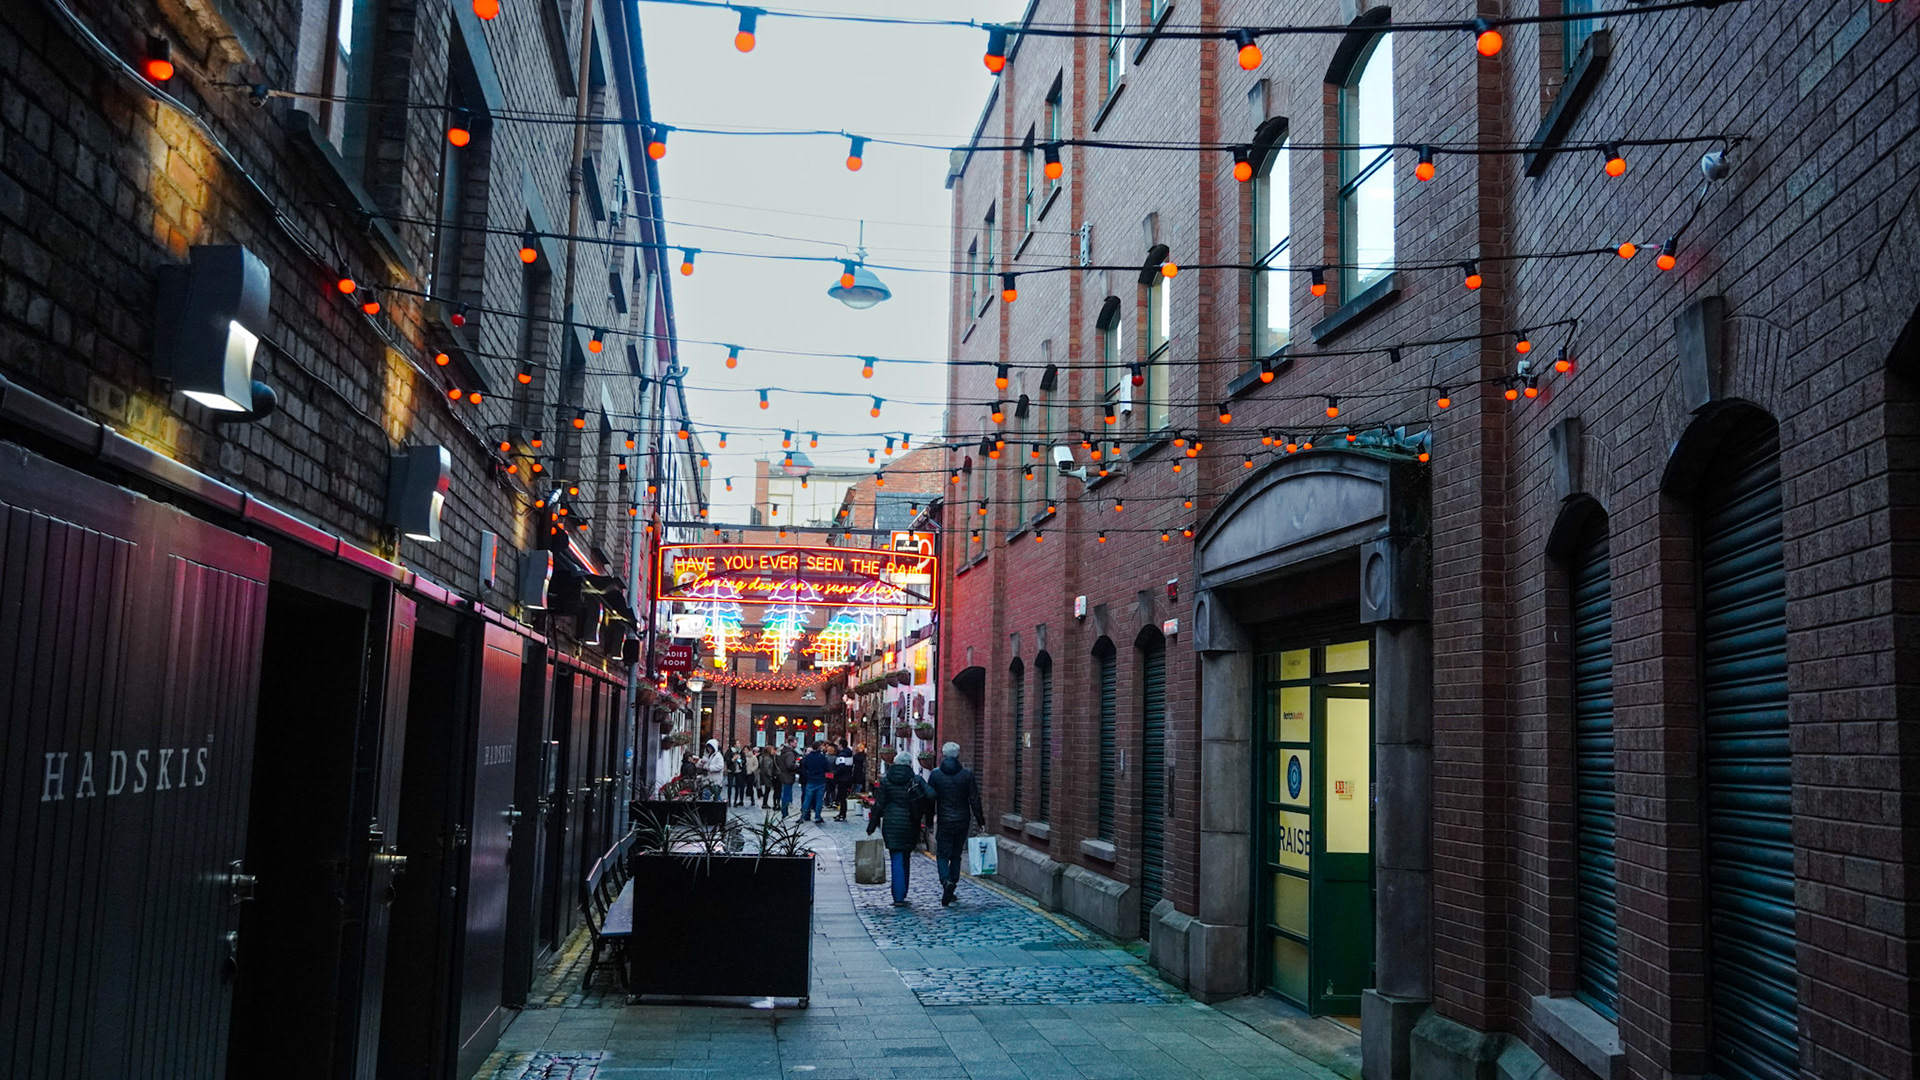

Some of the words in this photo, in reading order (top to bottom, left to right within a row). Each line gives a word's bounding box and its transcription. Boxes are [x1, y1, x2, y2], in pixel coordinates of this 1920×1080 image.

[674, 556, 716, 571] HAVE
[723, 555, 754, 570] YOU
[760, 555, 798, 570] EVER
[806, 556, 844, 572] SEEN
[851, 559, 881, 575] THE
[886, 562, 922, 577] RAIN
[692, 572, 747, 593] Coming
[748, 577, 788, 591] down
[790, 582, 809, 592] on
[810, 583, 824, 592] a
[824, 582, 868, 598] sunny
[484, 744, 512, 766] HADSKIS
[40, 747, 208, 803] HADSKIS
[1279, 826, 1311, 856] RAISE
